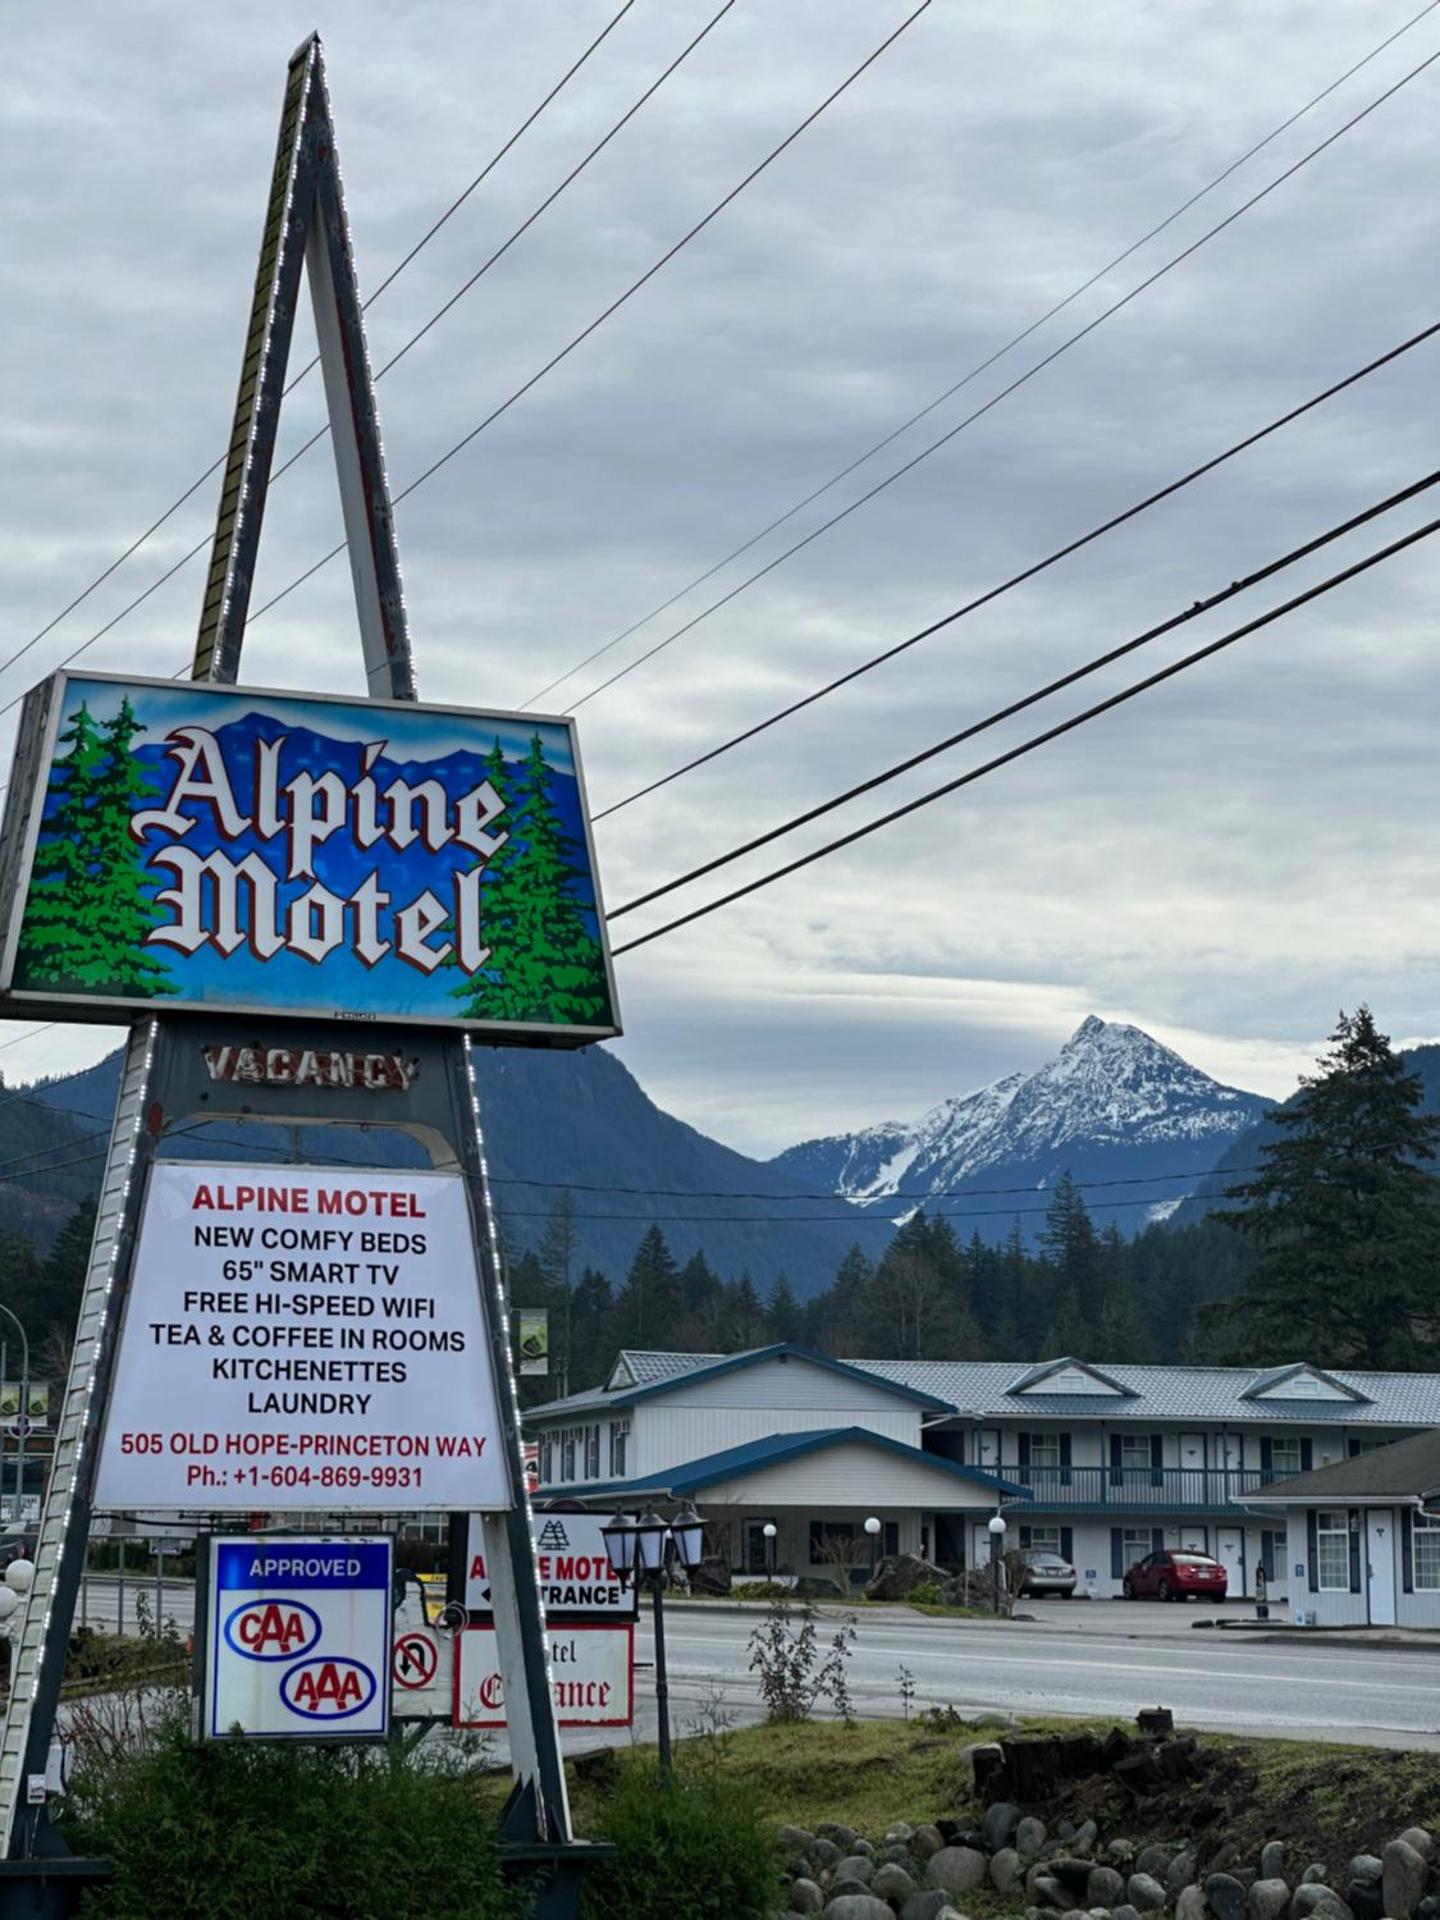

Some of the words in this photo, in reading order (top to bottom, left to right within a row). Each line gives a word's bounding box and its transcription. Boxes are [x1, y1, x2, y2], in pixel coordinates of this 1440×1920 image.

[129, 726, 510, 882] Alpine
[142, 845, 493, 976] Motel
[203, 1046, 419, 1091] VACANCY
[191, 1184, 310, 1214] ALPINE
[317, 1189, 427, 1219] MOTEL
[193, 1225, 255, 1249] NEW
[260, 1227, 355, 1253] COMFY
[360, 1231, 428, 1256] BEDS
[221, 1259, 265, 1282] 65"
[269, 1260, 361, 1285] SMART
[364, 1264, 401, 1287] TV
[183, 1291, 250, 1315] FREE
[254, 1292, 376, 1318] HI-SPEED
[380, 1297, 436, 1320] WIFI
[148, 1323, 203, 1347] TEA
[207, 1325, 226, 1347] &
[231, 1325, 335, 1350] COFFEE
[339, 1327, 366, 1350] IN
[371, 1329, 467, 1353] ROOMS
[212, 1358, 408, 1384] KITCHENETTES
[247, 1392, 373, 1416] LAUNDRY
[120, 1433, 165, 1455] 505
[169, 1432, 220, 1455] OLD
[224, 1433, 430, 1457] HOPE-PRINCETON
[434, 1436, 487, 1458] WAY
[186, 1464, 229, 1488] Ph.:
[232, 1465, 422, 1489] +1-604-869-9931
[250, 1559, 362, 1577] APPROVED
[239, 1604, 306, 1653] CAA
[294, 1663, 363, 1711] AAA
